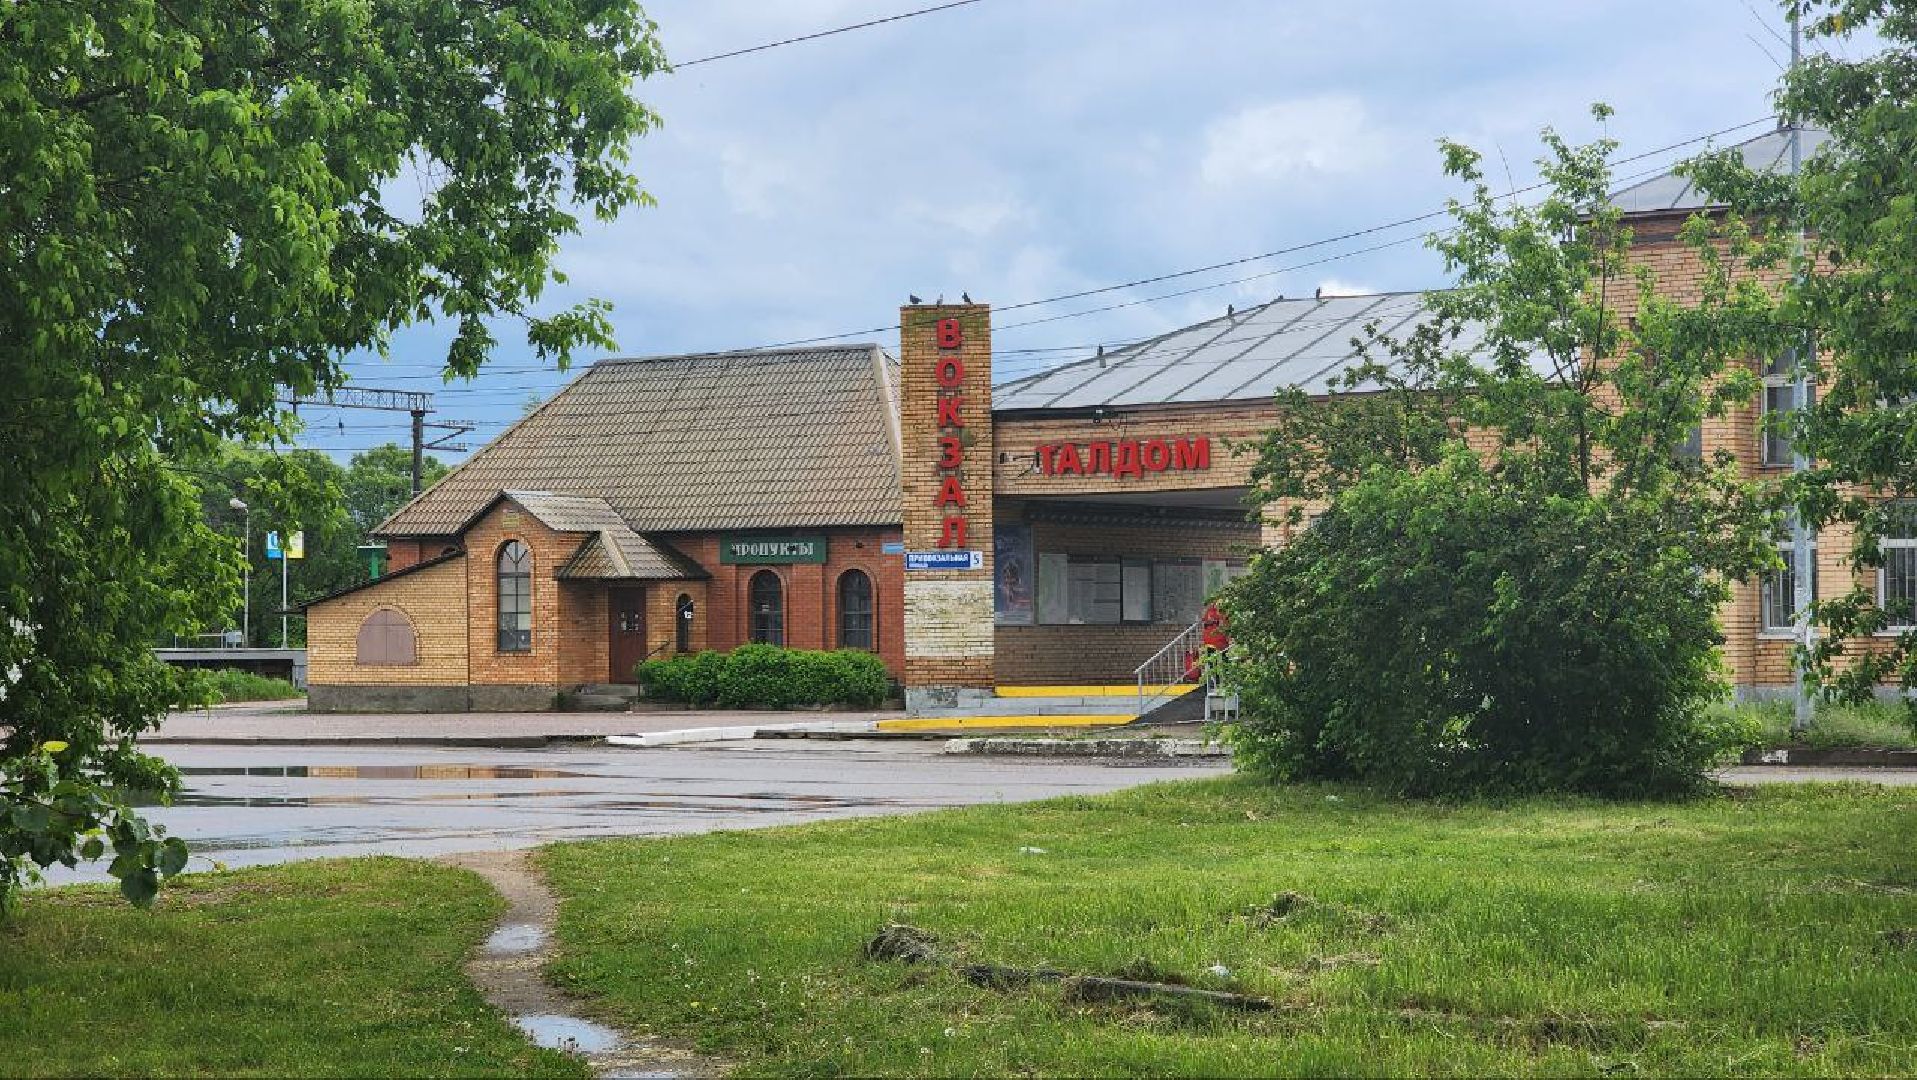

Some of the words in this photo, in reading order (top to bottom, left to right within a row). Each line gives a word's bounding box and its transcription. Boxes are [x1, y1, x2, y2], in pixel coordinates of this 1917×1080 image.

[933, 318, 966, 548] ВОКЗАЛ
[1039, 435, 1211, 480] ТАЛДОМ
[973, 553, 981, 565] 5
